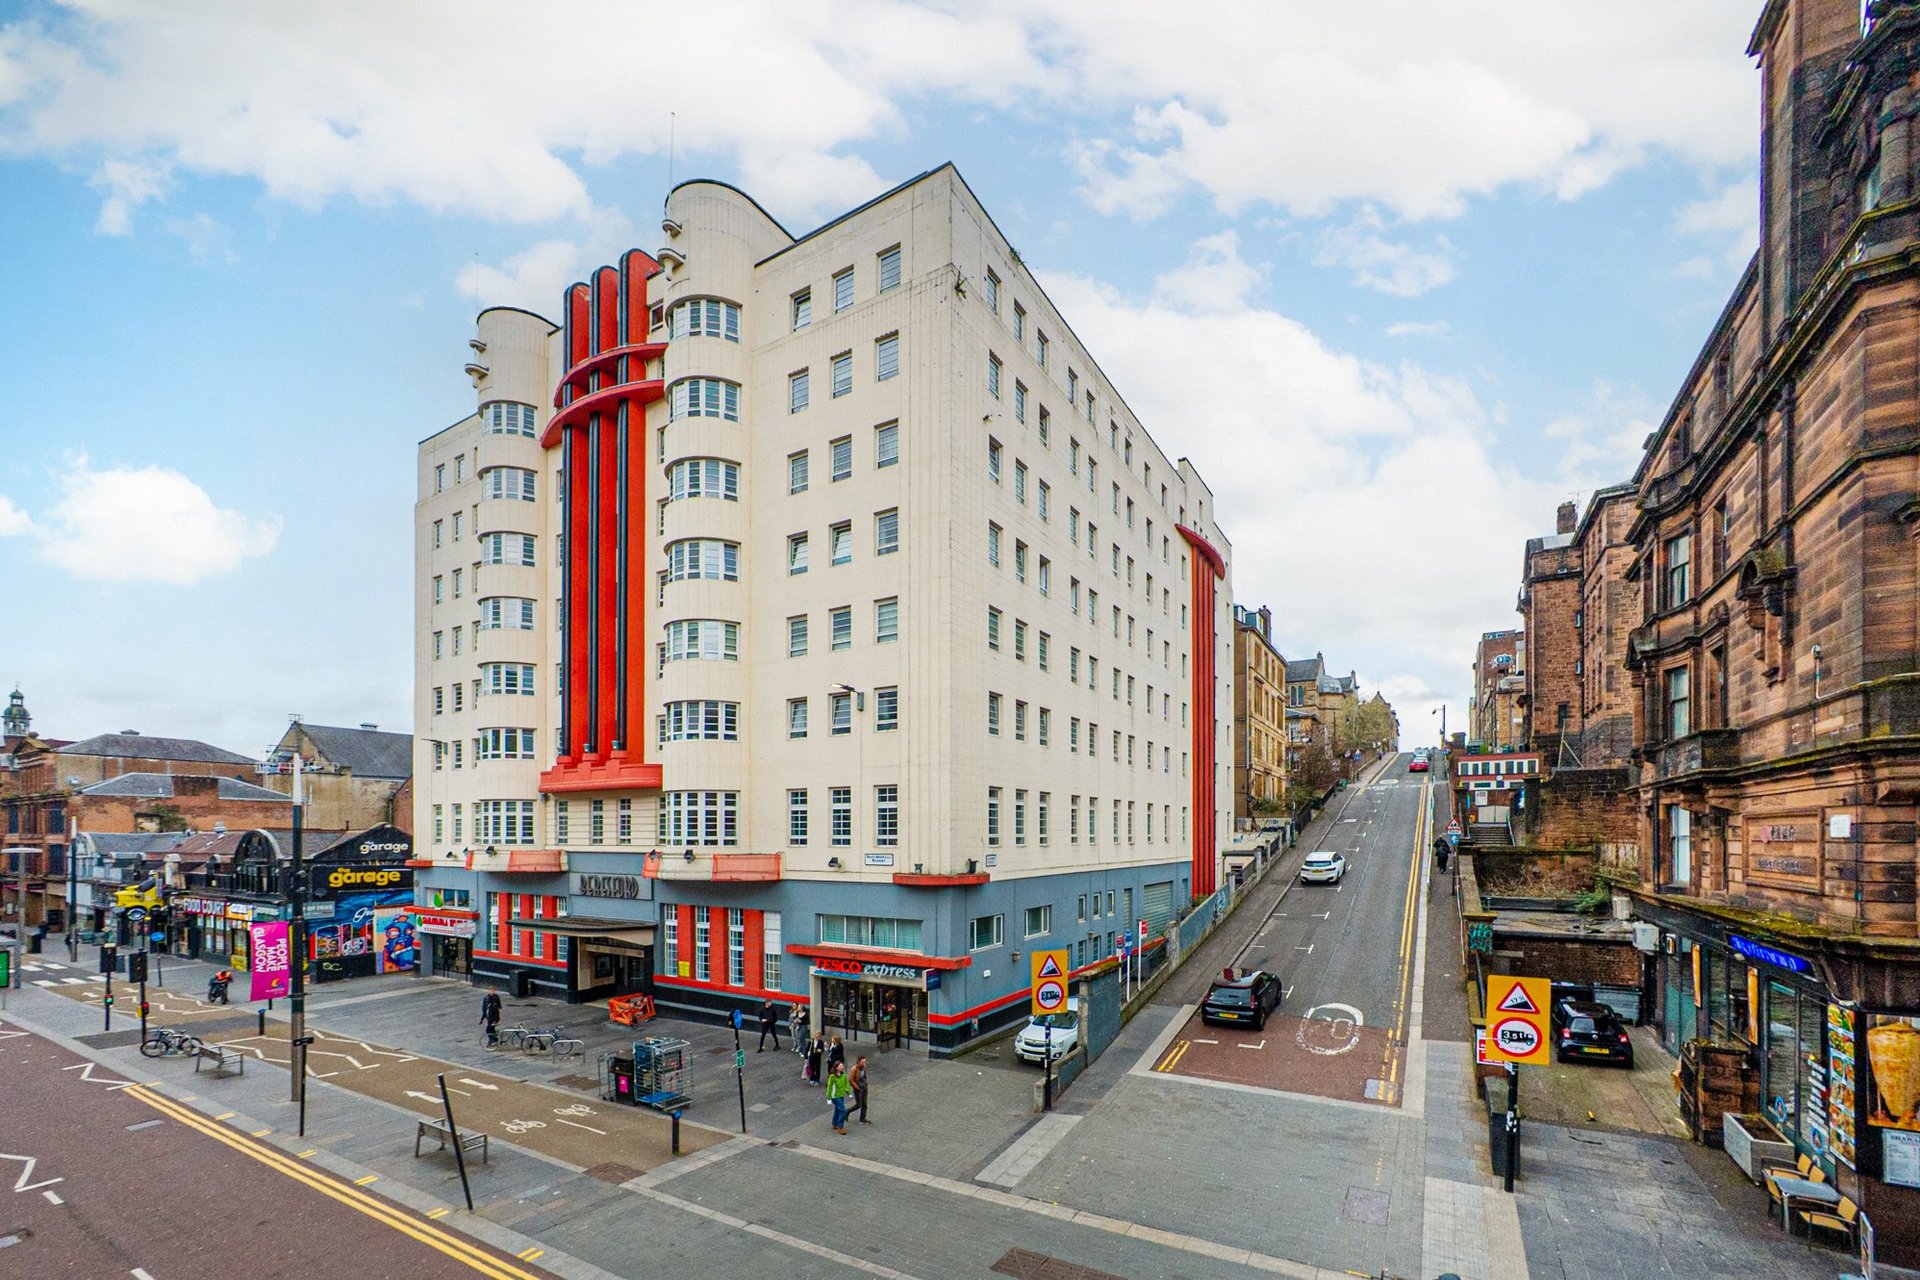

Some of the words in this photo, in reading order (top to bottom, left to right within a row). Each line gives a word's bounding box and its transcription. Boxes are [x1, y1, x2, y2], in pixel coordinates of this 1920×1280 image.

[360, 843, 408, 854] garage
[329, 871, 401, 888] garage
[580, 874, 639, 899] BERESFORD
[202, 899, 225, 916] COURT
[253, 927, 266, 973] GLASGOW
[266, 946, 277, 972] MAKE
[276, 937, 288, 971] PEOPLE
[814, 957, 863, 974] TESCO
[864, 964, 916, 979] express
